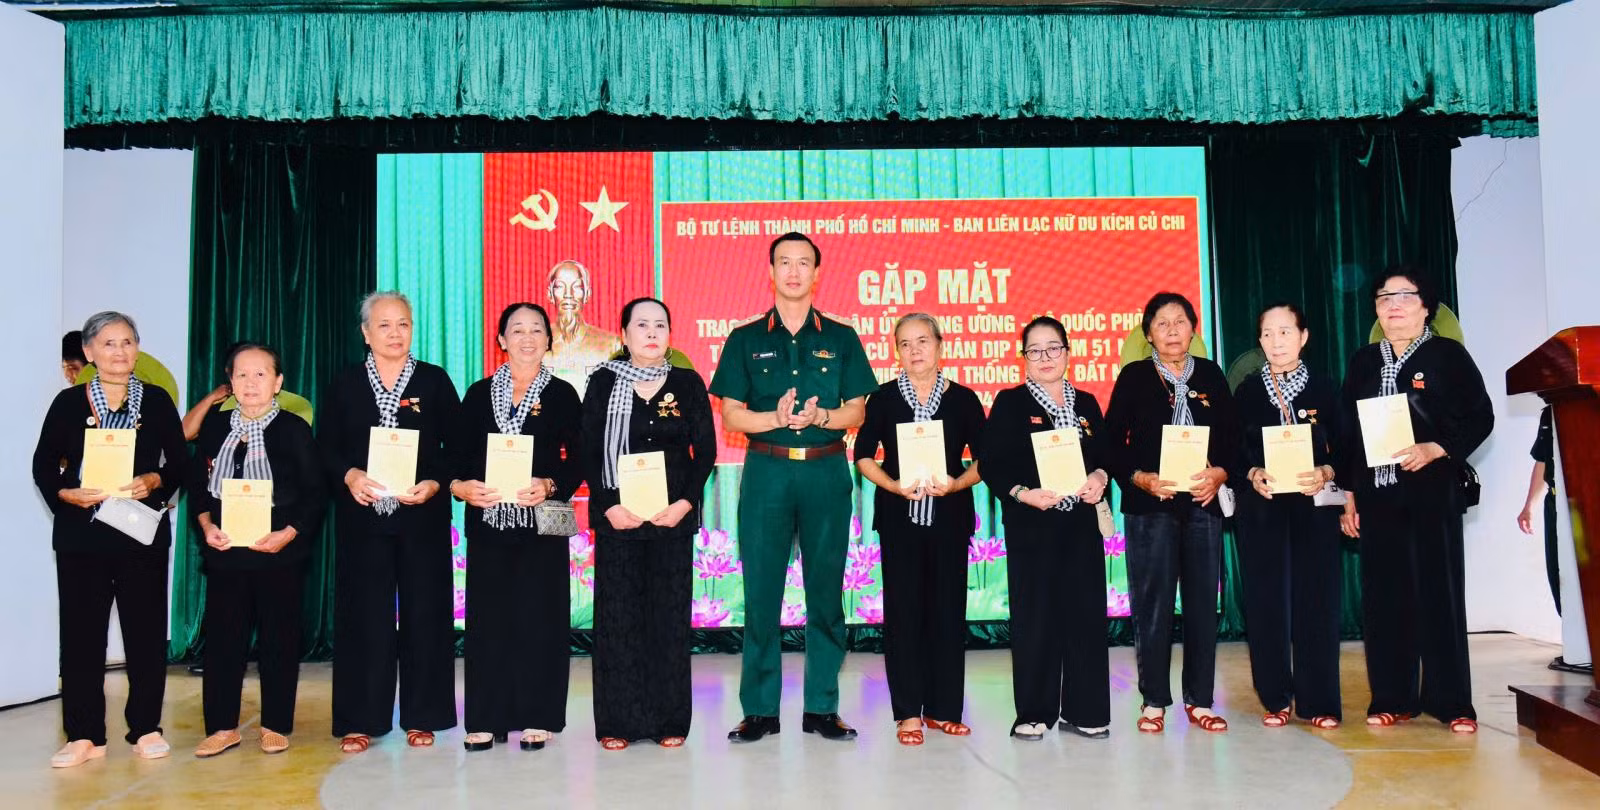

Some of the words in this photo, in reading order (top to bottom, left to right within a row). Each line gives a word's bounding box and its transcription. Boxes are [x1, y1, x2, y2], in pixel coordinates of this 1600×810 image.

[676, 217, 697, 239] BỘ
[700, 218, 720, 236] TƯ
[722, 217, 761, 239] LỆNH
[763, 216, 811, 235] THÀNH
[815, 213, 845, 234] PHỐ
[872, 215, 896, 234] CHÍ
[901, 217, 940, 234] MINH
[953, 217, 984, 233] BAN
[987, 213, 1019, 233] LIÊN
[1023, 216, 1050, 236] LẠC
[1053, 213, 1076, 232] NỮ
[1078, 215, 1098, 232] DU
[1101, 212, 1135, 231] KÍCH
[1138, 210, 1158, 230] CỦ
[1160, 214, 1185, 230] CHI
[858, 262, 927, 313] GẶP
[938, 261, 1012, 312] MẶT
[967, 313, 1016, 335] ƯƠNG
[1060, 307, 1107, 334] QUỐC
[865, 336, 889, 360] CỦ
[942, 337, 977, 359] HÂN
[982, 340, 1010, 363] DỊP
[1091, 338, 1111, 357] 51
[962, 360, 1021, 385] THỐNG
[1074, 358, 1108, 382] ĐẤT
